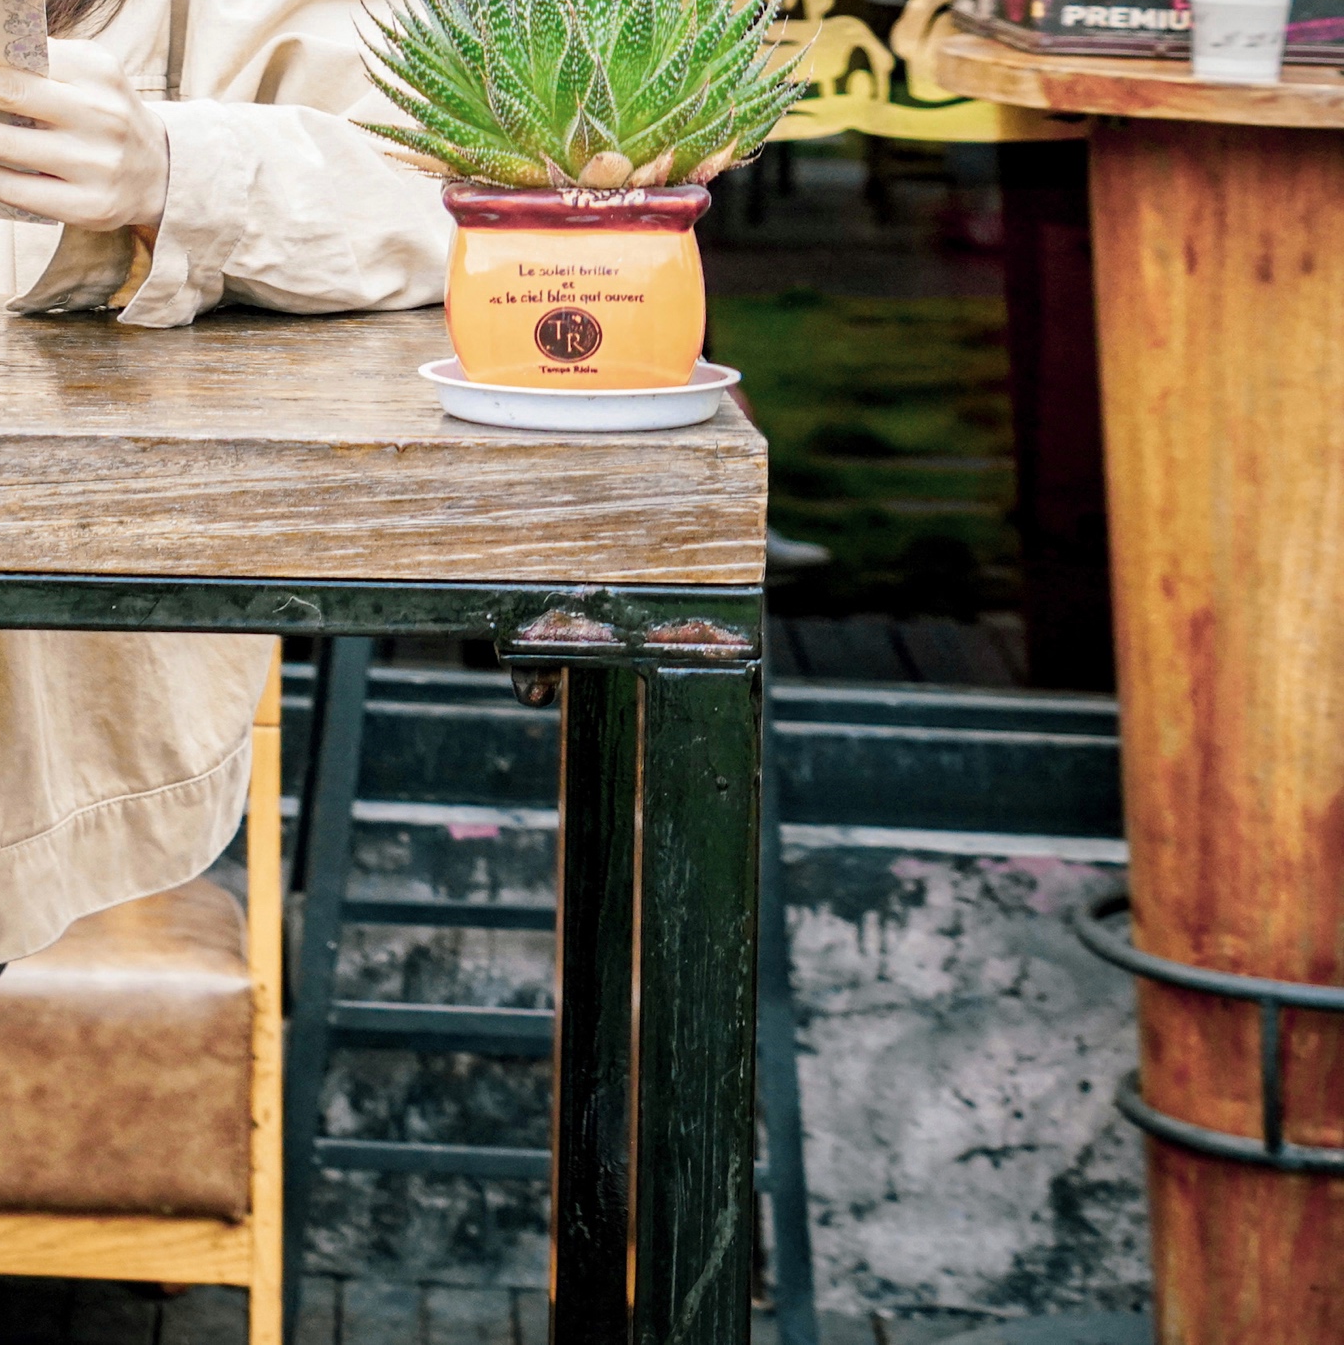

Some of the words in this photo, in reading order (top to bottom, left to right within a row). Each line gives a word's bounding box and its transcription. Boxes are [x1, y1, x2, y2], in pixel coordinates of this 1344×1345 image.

[519, 264, 535, 277] Le
[506, 291, 517, 304] le
[520, 289, 543, 303] ciel
[547, 289, 576, 303] bleu
